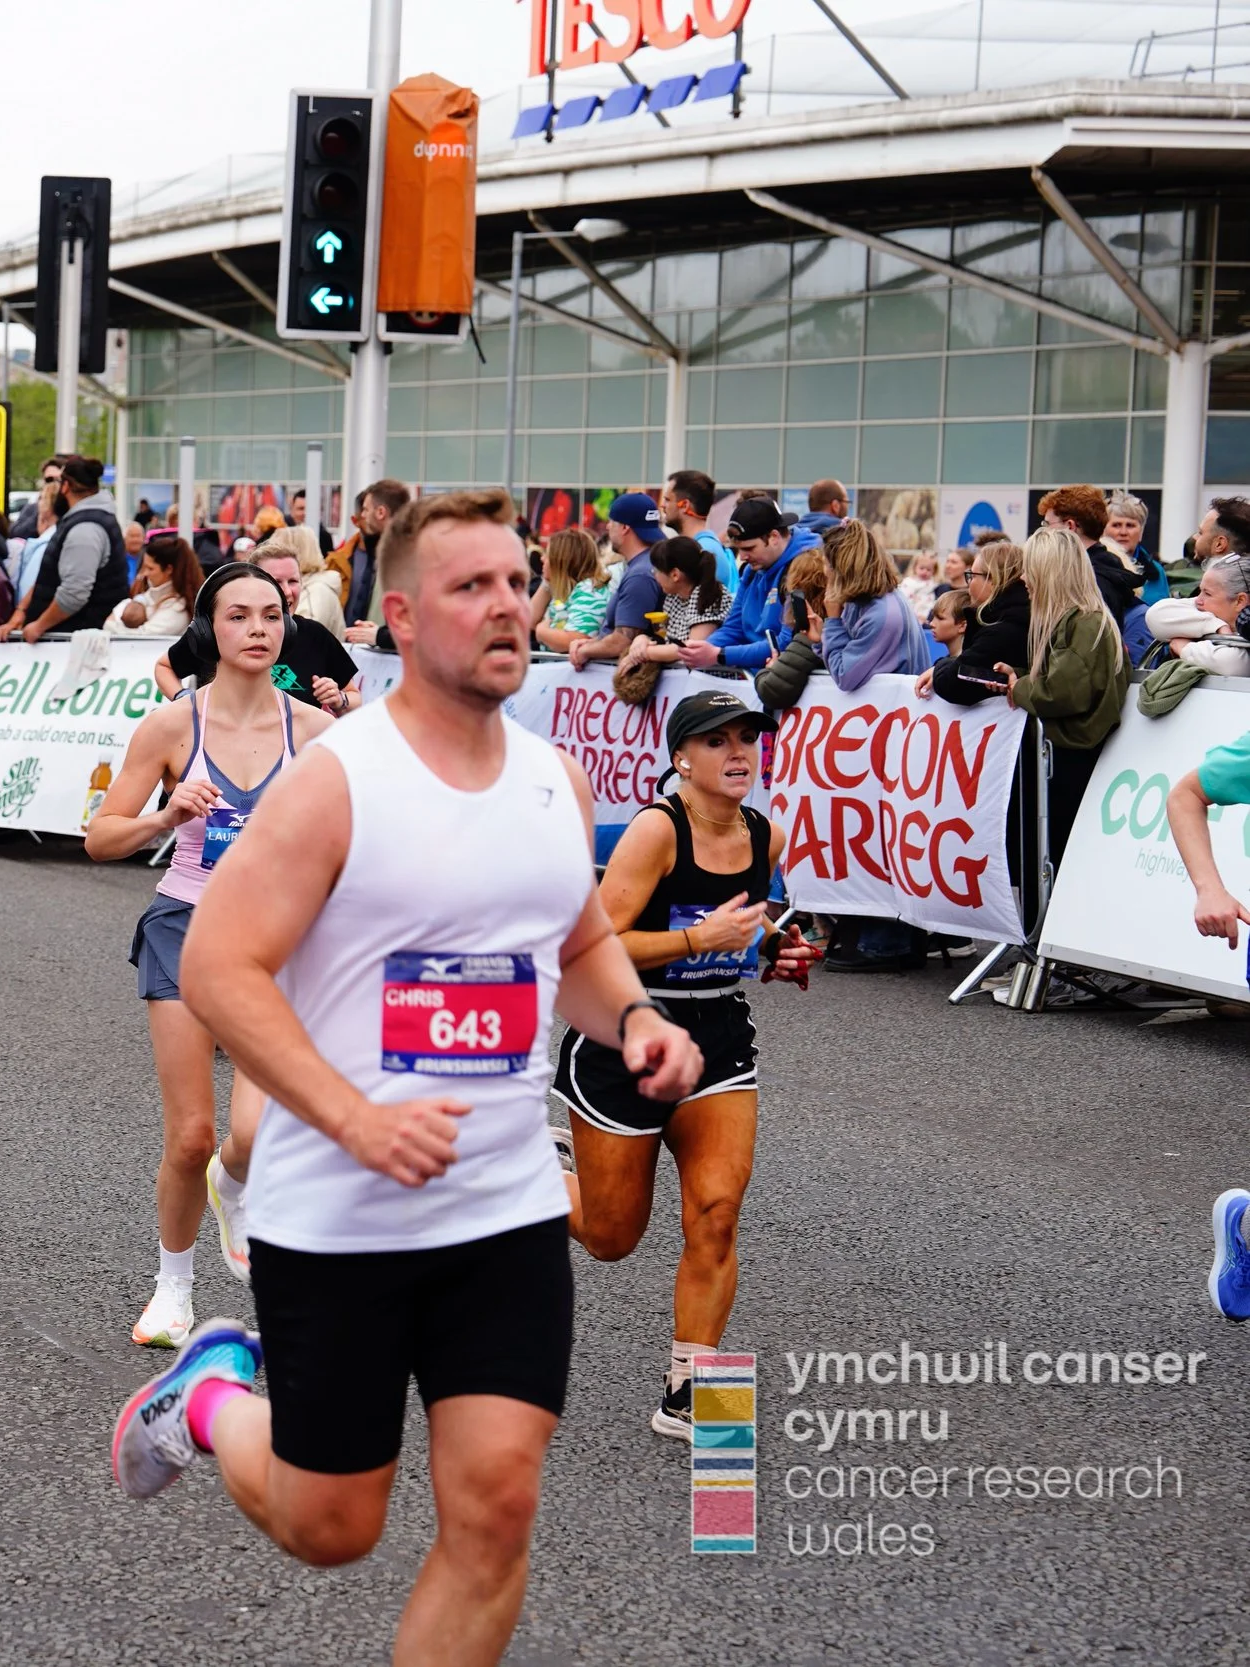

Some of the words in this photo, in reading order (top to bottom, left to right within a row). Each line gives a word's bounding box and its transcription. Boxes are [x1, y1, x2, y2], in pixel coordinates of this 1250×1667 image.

[517, 0, 751, 77] TESCO
[12, 729, 21, 740] a
[21, 725, 51, 742] cold
[50, 730, 76, 744] one
[77, 731, 95, 745] on
[97, 732, 125, 748] us...
[550, 687, 669, 750] BRECON
[554, 742, 659, 806] RREG
[774, 704, 997, 810] BRECON
[208, 831, 241, 842] LAUR
[771, 792, 989, 909] CARREG
[385, 988, 445, 1008] CHRIS
[680, 967, 740, 979] #RUNSWANSEA
[429, 1009, 502, 1050] 643
